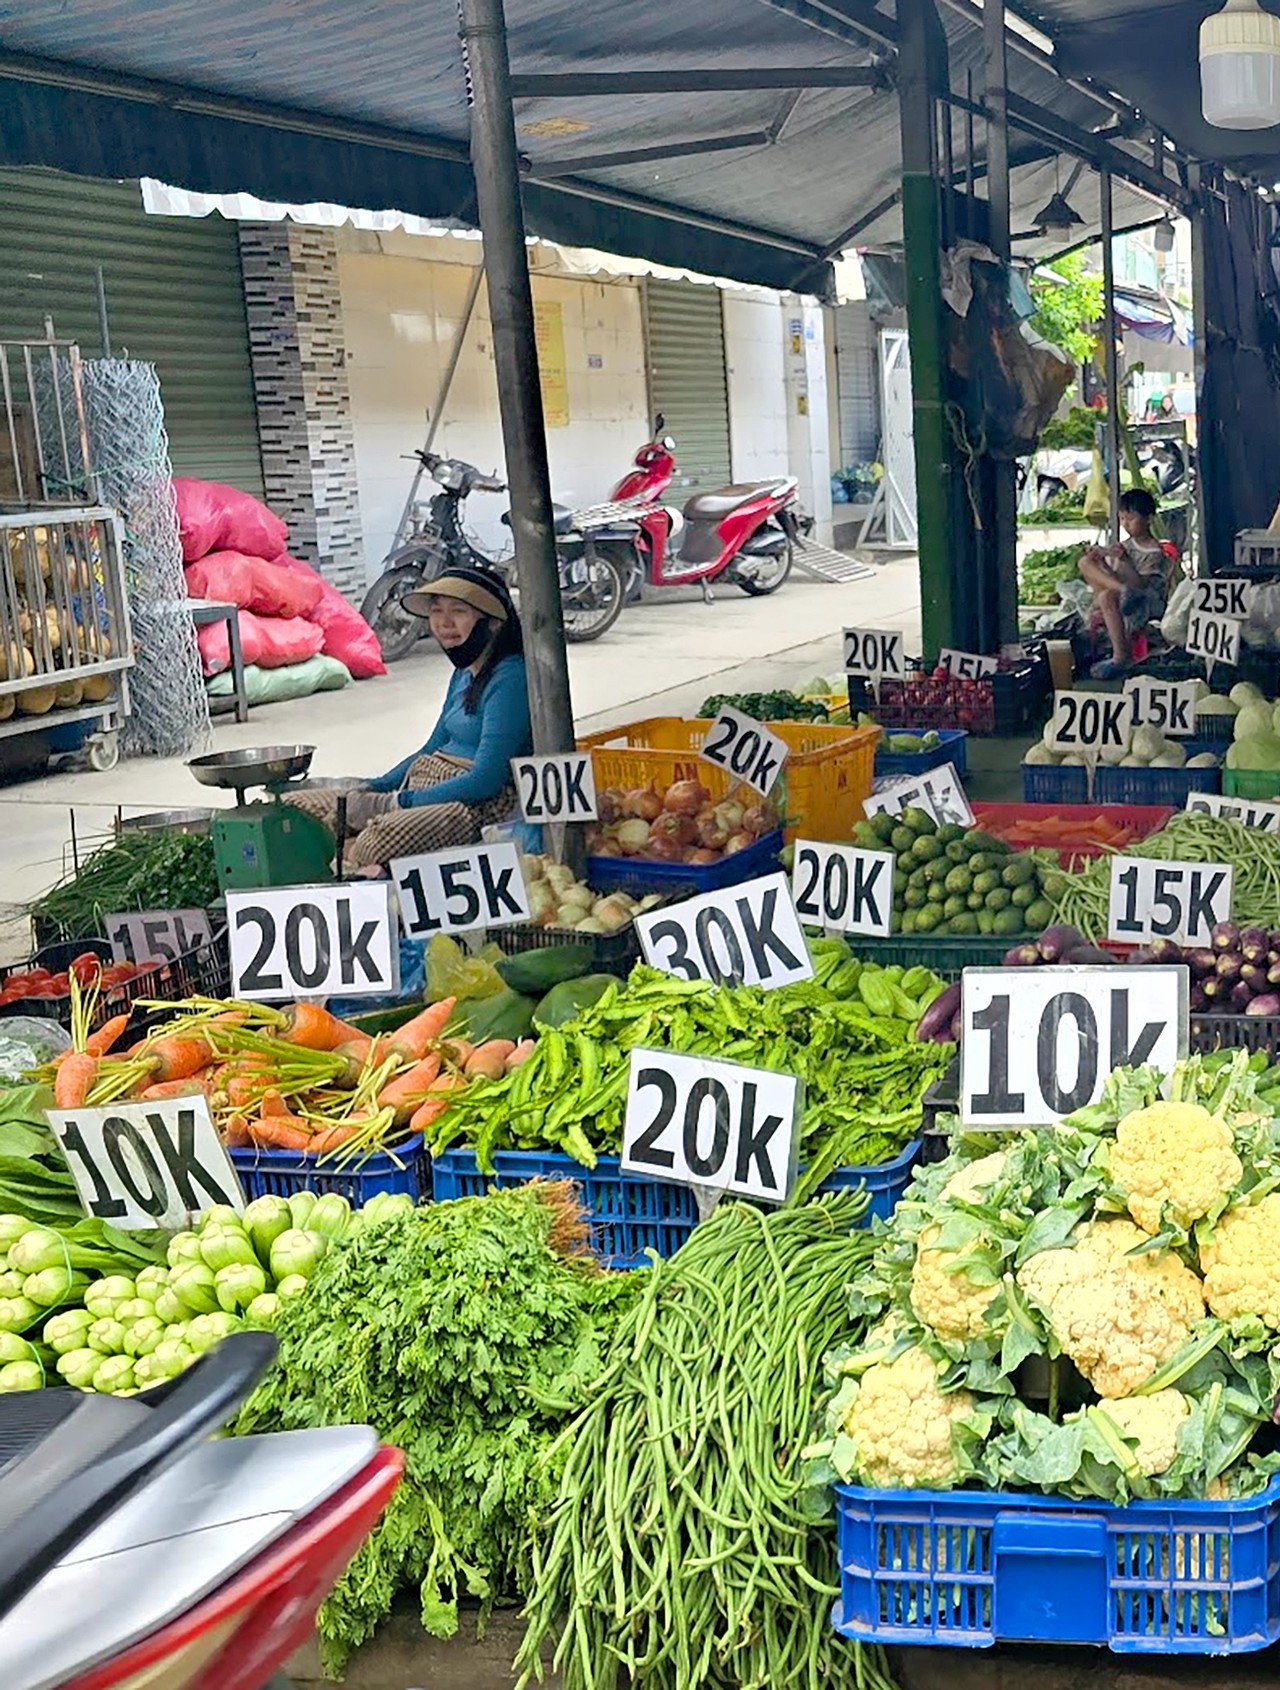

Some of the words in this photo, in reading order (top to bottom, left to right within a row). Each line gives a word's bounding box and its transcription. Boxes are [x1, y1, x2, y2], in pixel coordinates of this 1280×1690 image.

[1198, 582, 1247, 613] 25K
[845, 632, 900, 673] 20K
[1189, 617, 1234, 660] 10k
[1056, 697, 1126, 745] 20K
[1128, 687, 1189, 729] 15k
[519, 760, 593, 816] 20K
[705, 716, 778, 789] 20k
[401, 854, 524, 933] 15k
[796, 848, 885, 925] 20K
[1116, 865, 1227, 937] 15K
[235, 899, 383, 992] 20k
[648, 887, 804, 988] 30K
[971, 988, 1167, 1114] 10k
[60, 1109, 234, 1217] 10K
[629, 1068, 784, 1190] 20k
